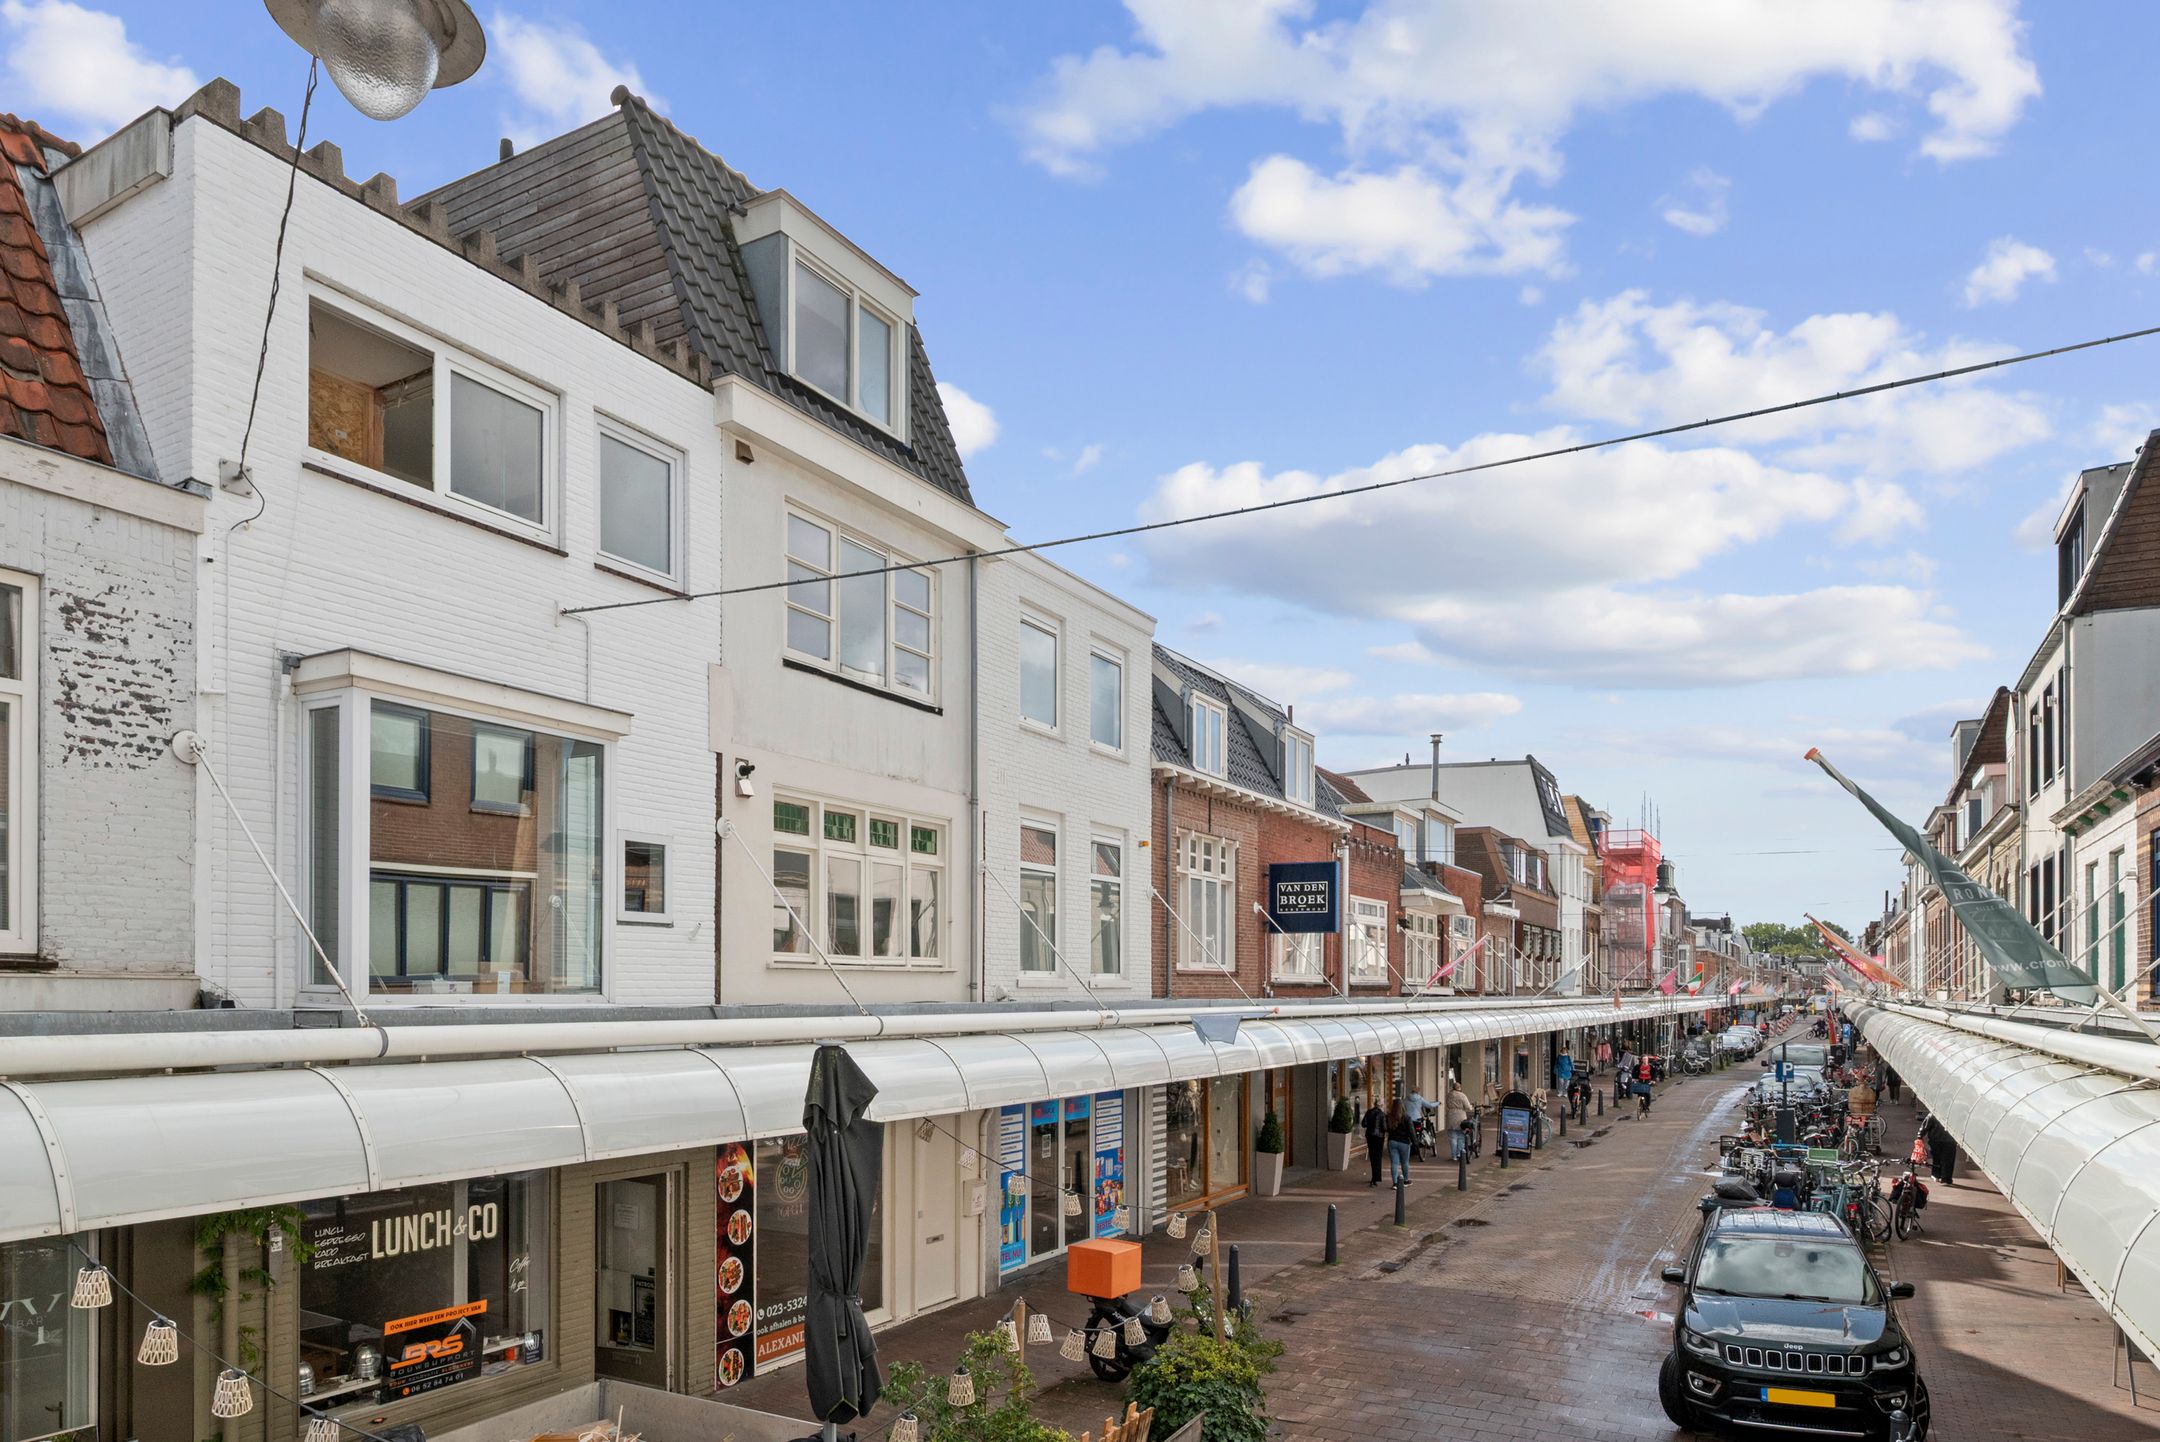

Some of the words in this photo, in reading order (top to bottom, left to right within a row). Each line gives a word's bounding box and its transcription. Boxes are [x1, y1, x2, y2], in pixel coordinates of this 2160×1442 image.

[1280, 884, 1300, 892] VAN
[1304, 884, 1325, 892] DEN
[1953, 886, 1995, 900] RON
[1280, 895, 1325, 905] BROEK
[1782, 1062, 1793, 1076] P
[315, 1226, 344, 1238] LUNCH
[315, 1232, 366, 1248] ESPRESSO
[315, 1248, 339, 1258] KADO
[314, 1253, 369, 1270] BREAKFAST
[390, 1323, 403, 1331] OOK
[418, 1316, 433, 1324] WEER
[445, 1308, 470, 1319] PROJECT
[471, 1304, 481, 1312] VAN
[757, 1325, 769, 1335] ook
[770, 1319, 792, 1331] afhalen
[390, 1334, 464, 1370] BRS
